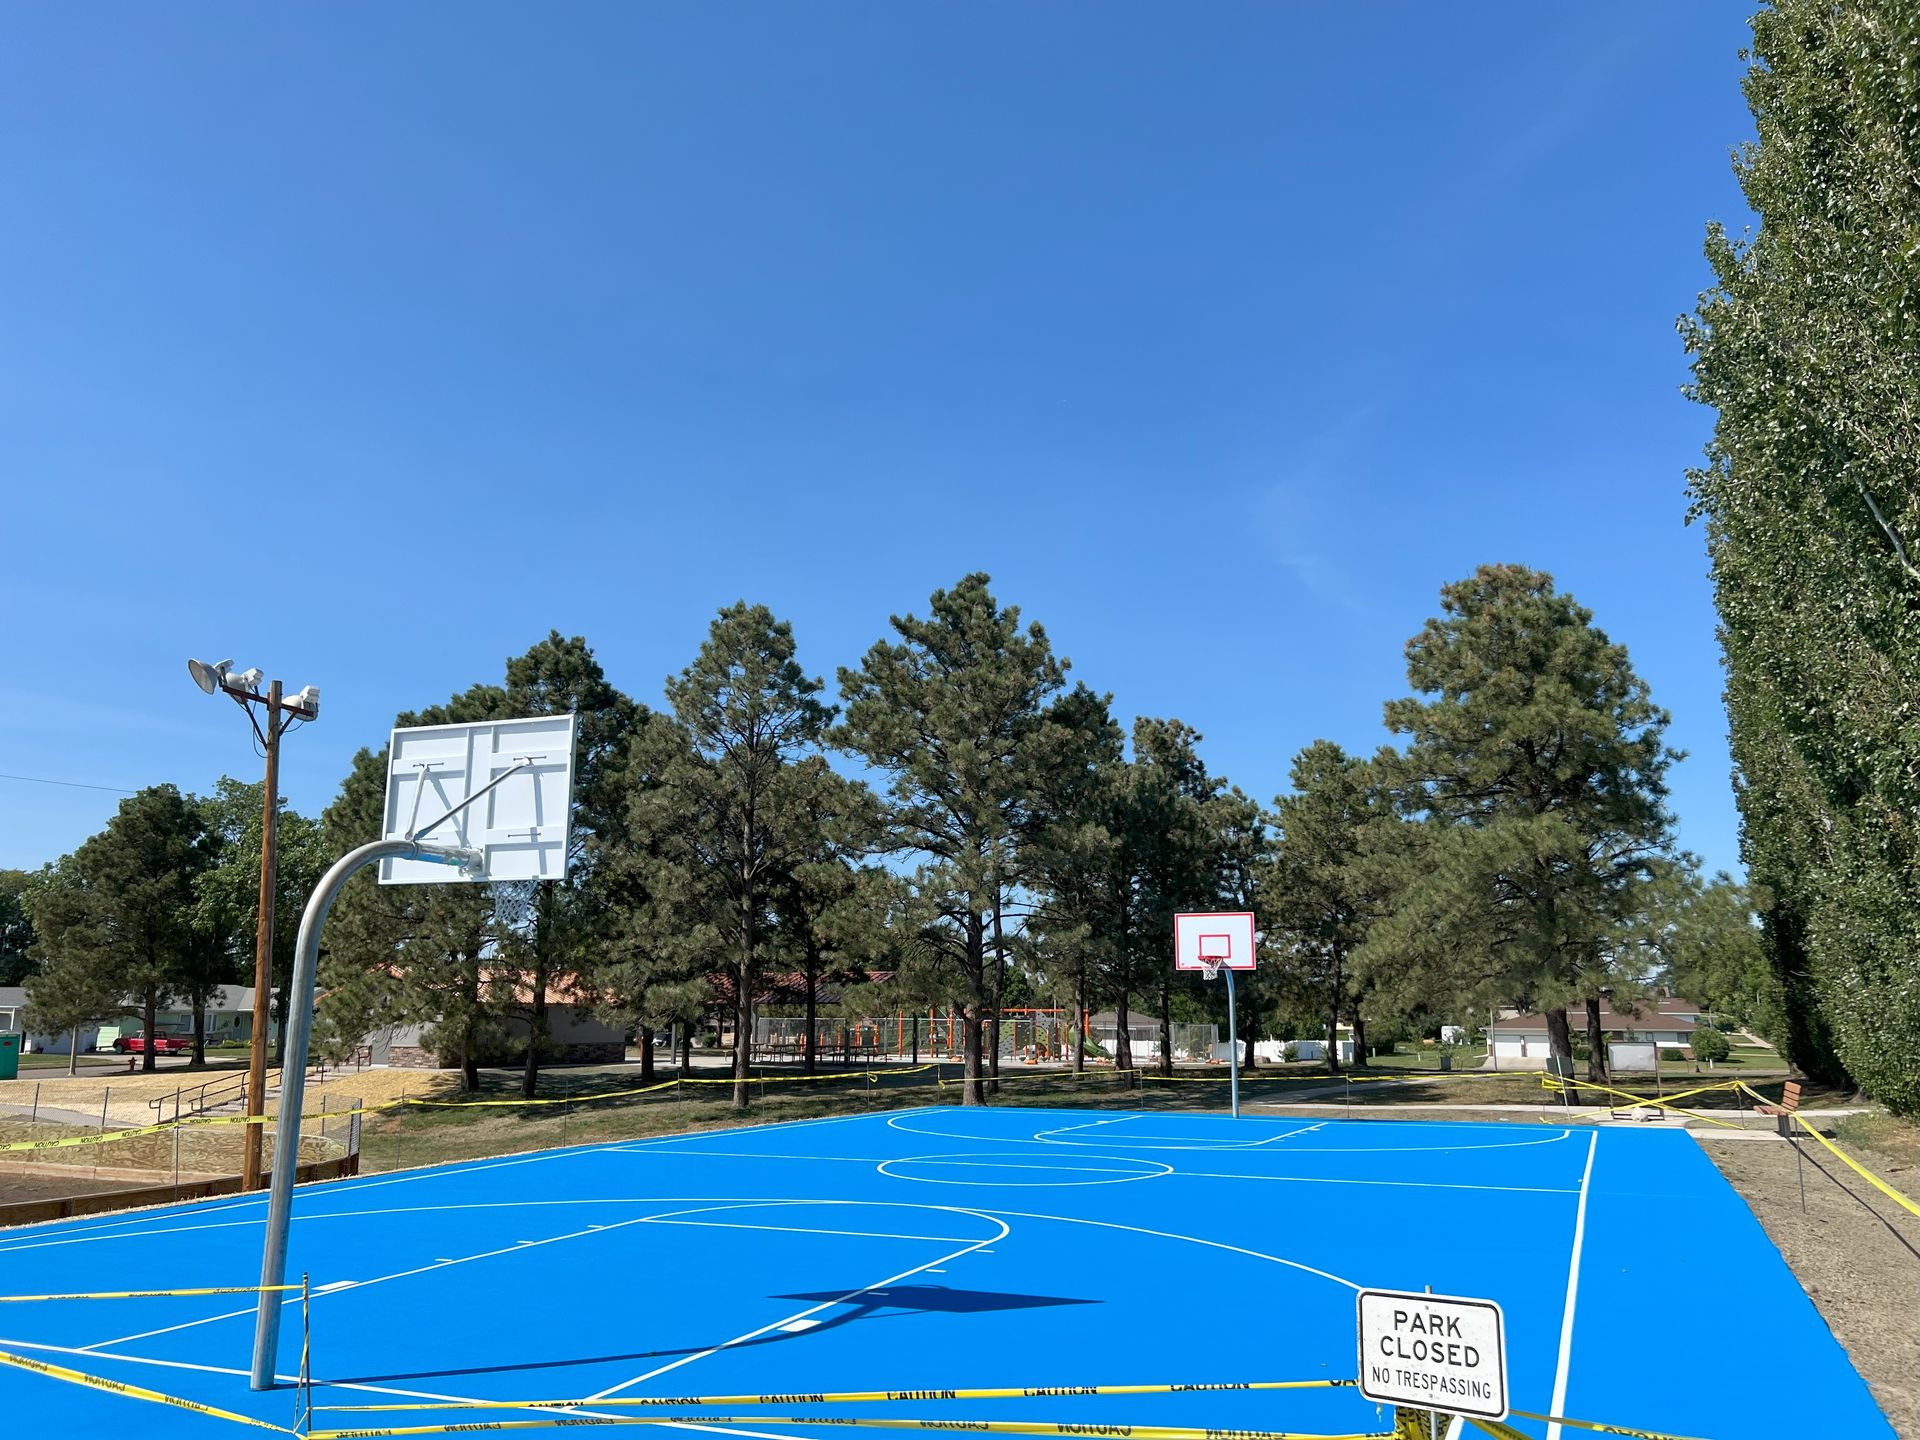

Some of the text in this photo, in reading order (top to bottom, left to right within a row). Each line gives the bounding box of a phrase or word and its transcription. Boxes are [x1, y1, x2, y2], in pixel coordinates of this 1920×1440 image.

[34, 1140, 59, 1148] CAUTION
[80, 1135, 103, 1144] CAUTION
[1393, 1310, 1462, 1339] PARK
[1380, 1335, 1480, 1368] CLOSED
[1372, 1366, 1491, 1399] NO TRESPASSING
